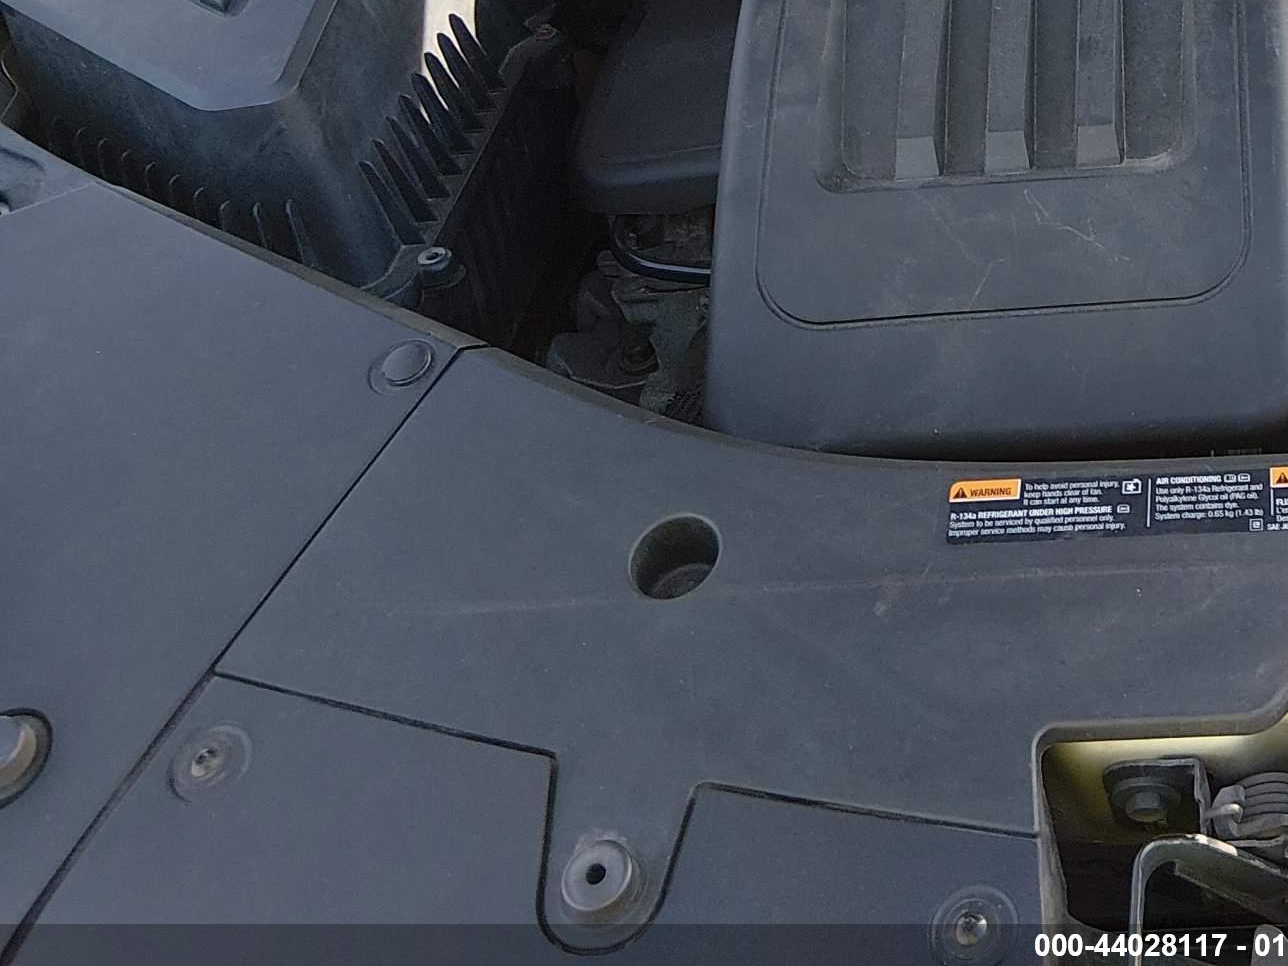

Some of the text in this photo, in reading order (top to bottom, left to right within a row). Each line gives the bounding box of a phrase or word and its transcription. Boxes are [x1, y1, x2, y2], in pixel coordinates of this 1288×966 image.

[970, 488, 1011, 497] WARNING
[978, 510, 1027, 518] REFRIGERANT
[1075, 506, 1112, 514] PRESSURE
